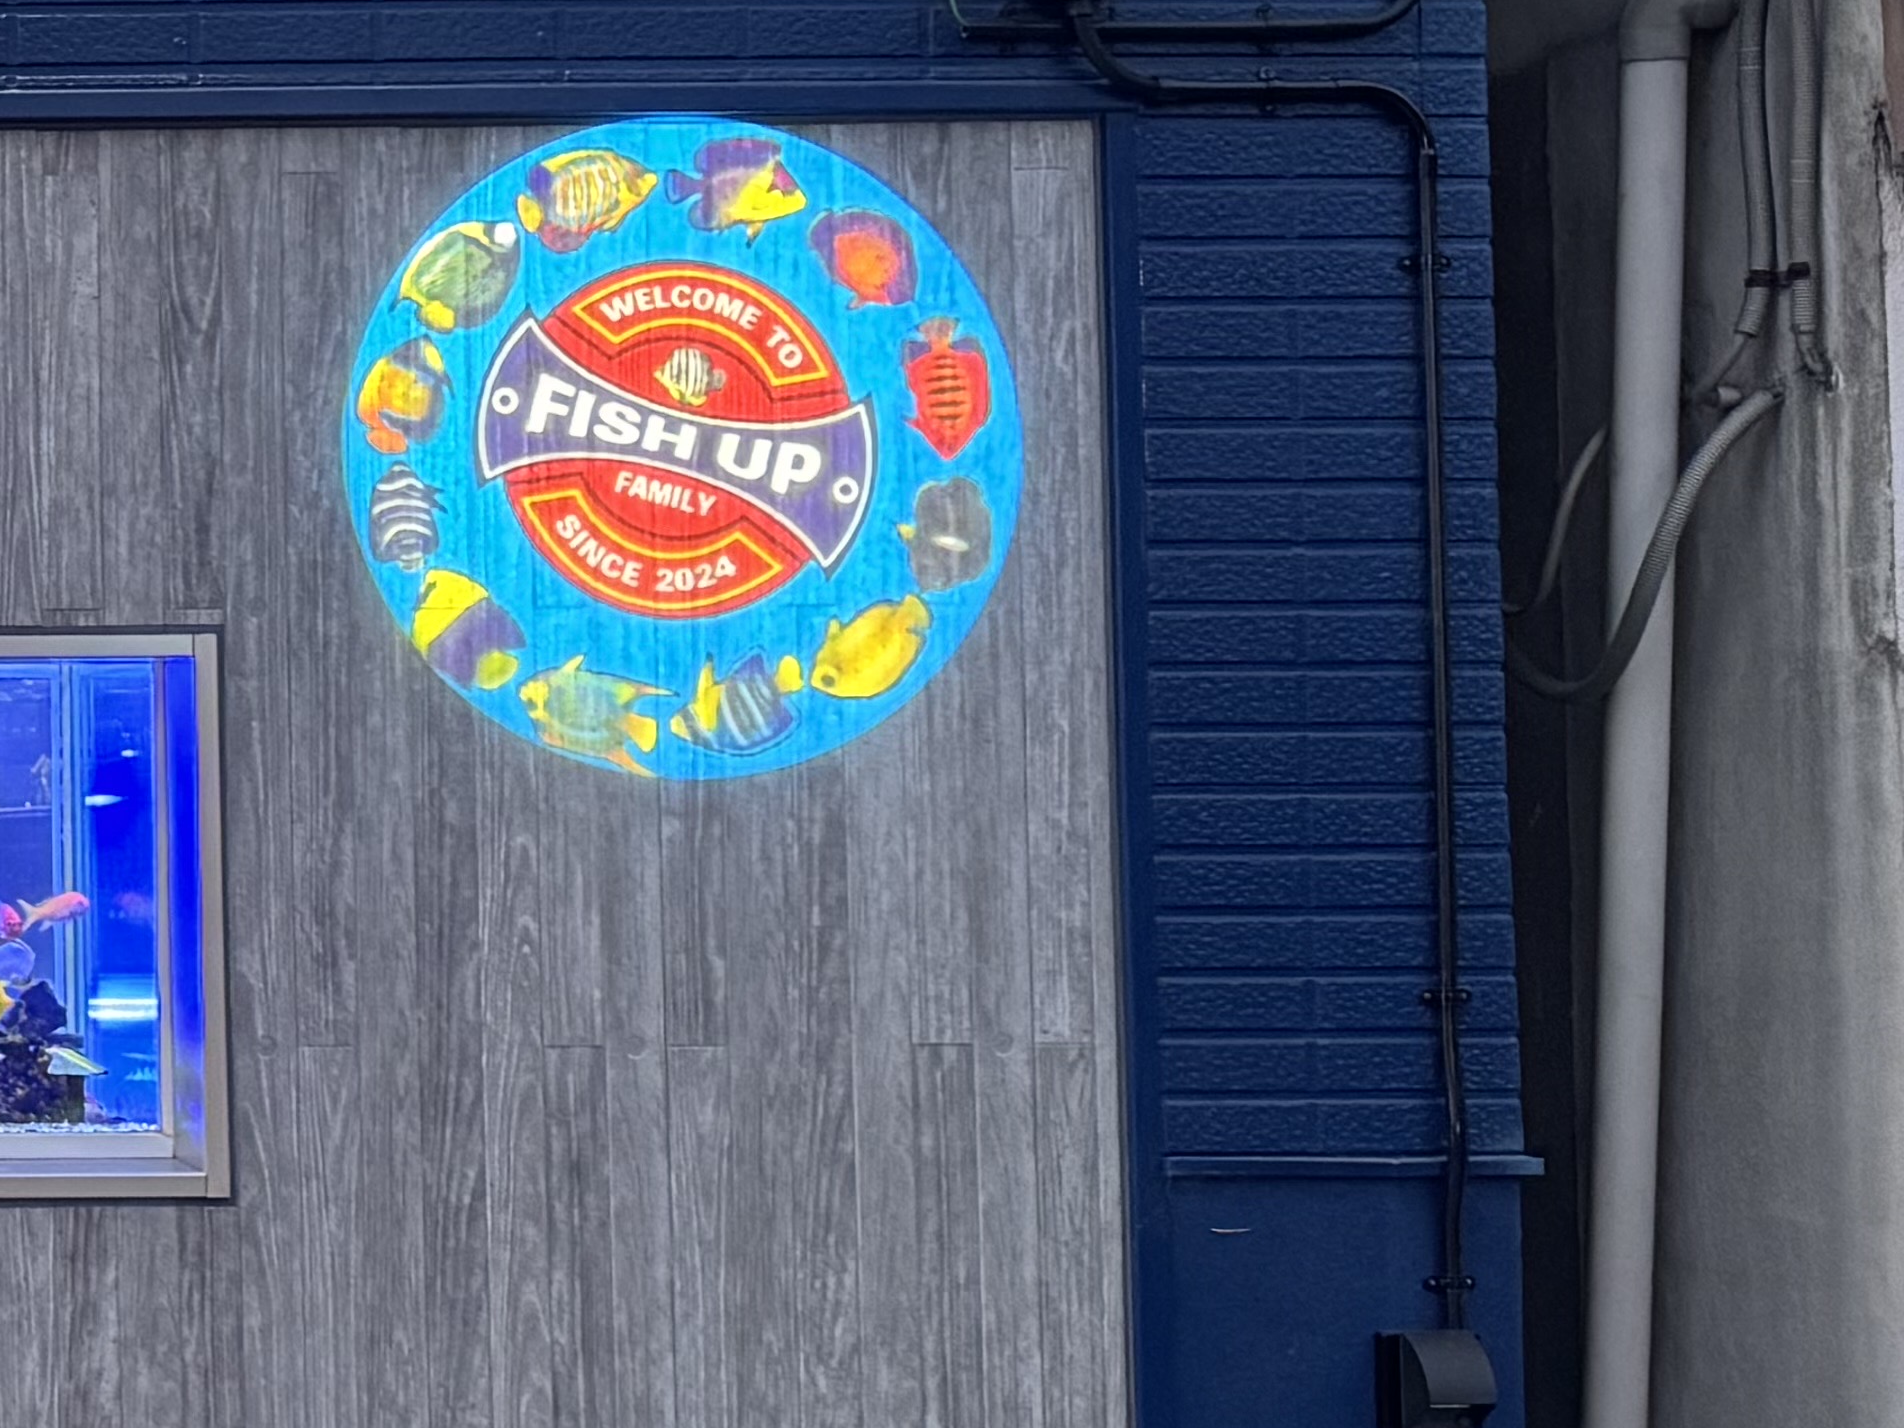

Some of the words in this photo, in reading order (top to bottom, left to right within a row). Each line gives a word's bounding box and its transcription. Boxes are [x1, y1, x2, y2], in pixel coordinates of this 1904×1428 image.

[599, 285, 763, 332] WELCOME
[766, 324, 803, 369] TO
[524, 372, 698, 461] FISH
[716, 433, 822, 495] UP
[614, 471, 718, 517] FAMILY
[555, 514, 644, 588] SINCE
[655, 555, 738, 593] 2024
